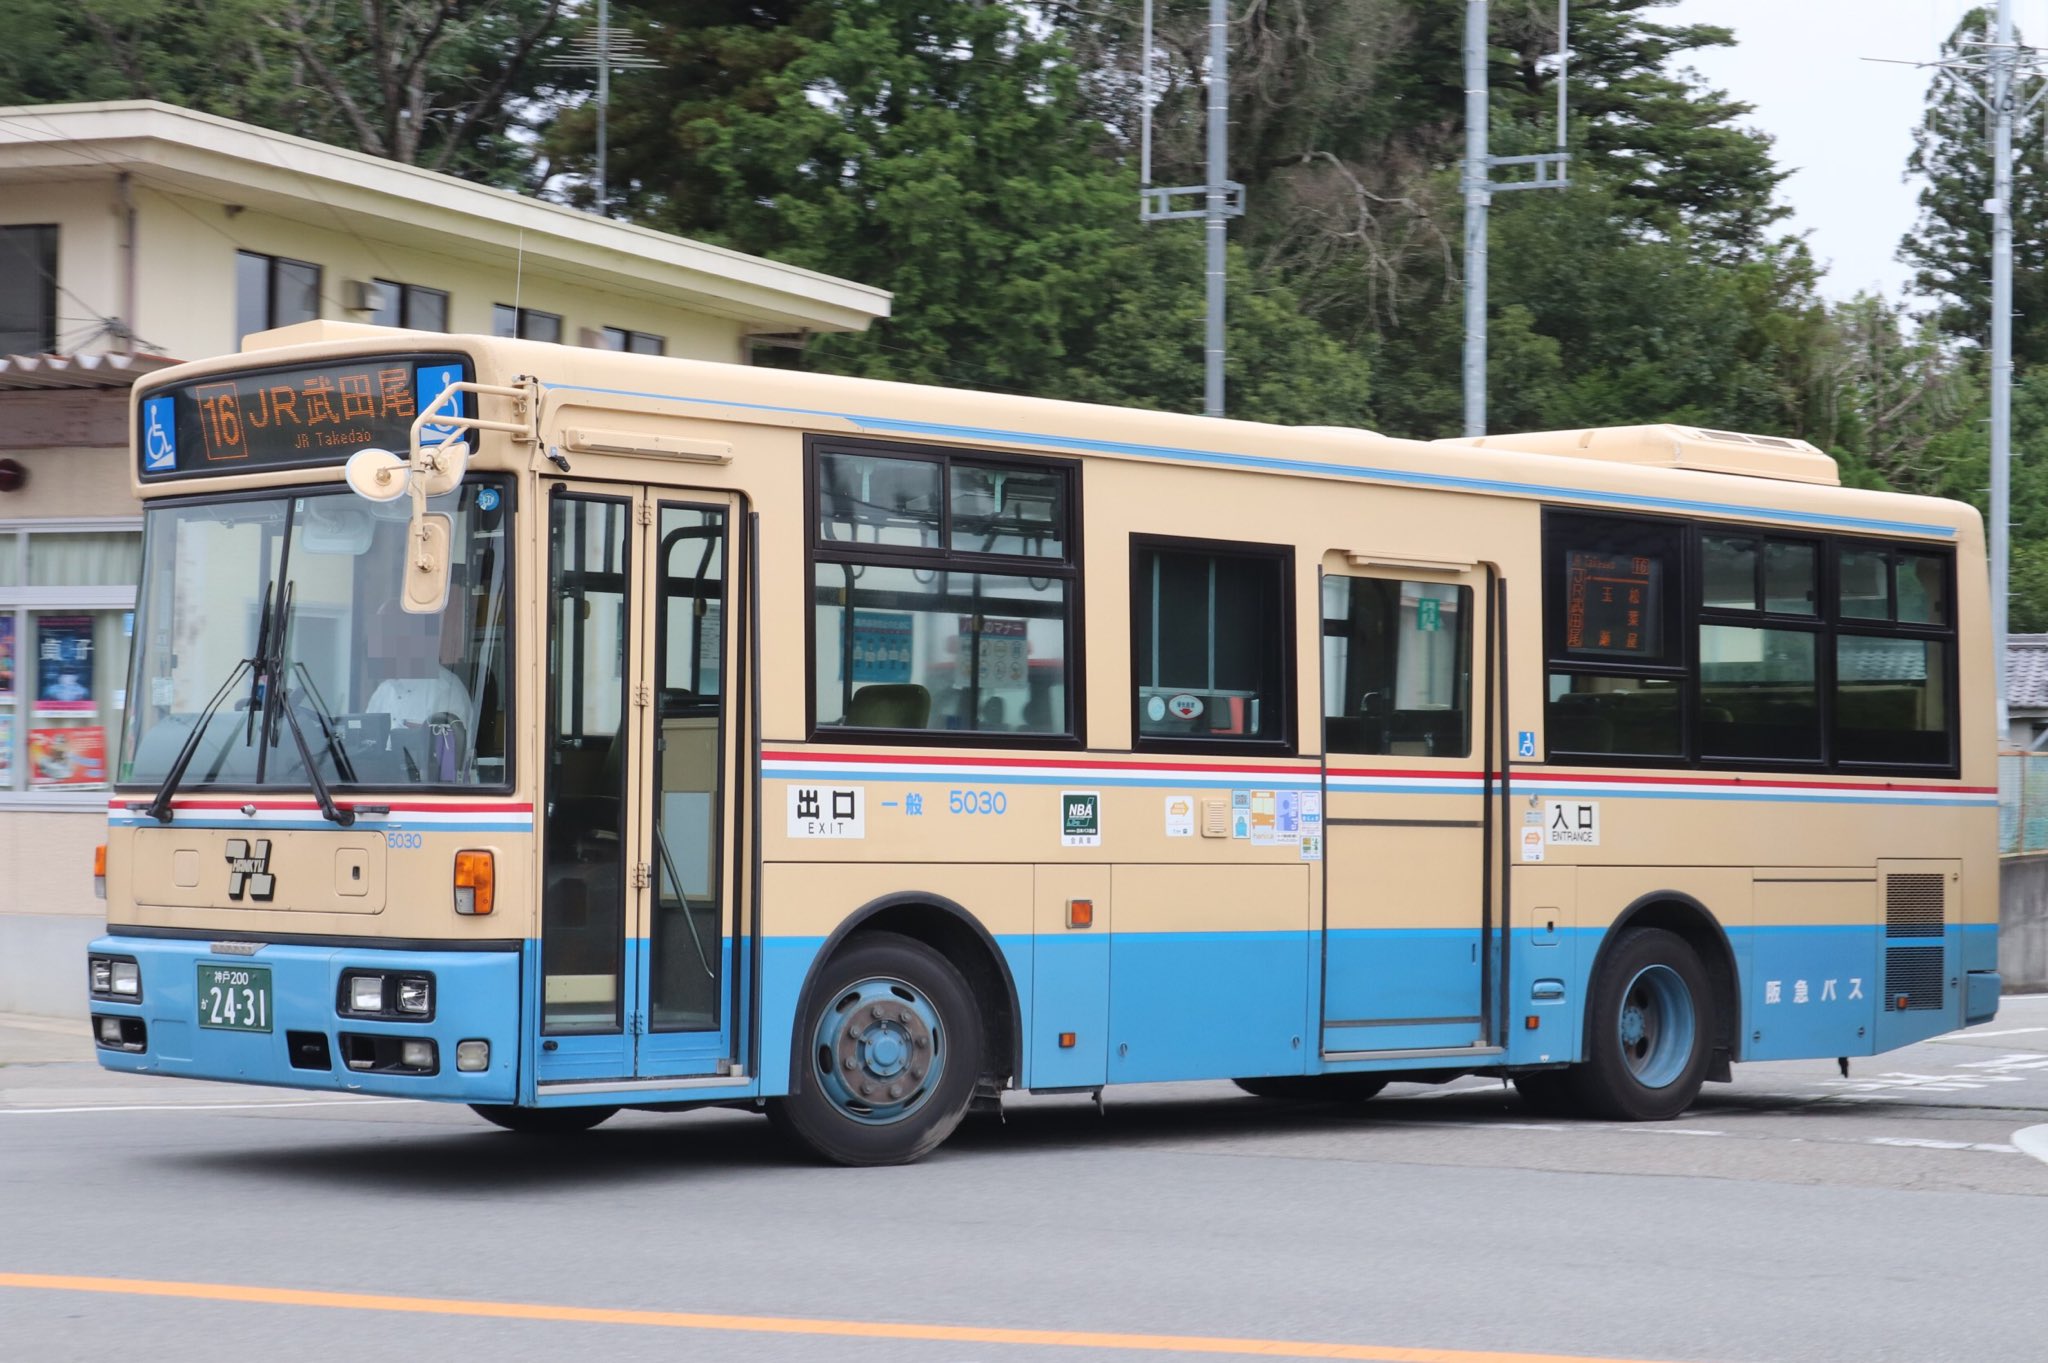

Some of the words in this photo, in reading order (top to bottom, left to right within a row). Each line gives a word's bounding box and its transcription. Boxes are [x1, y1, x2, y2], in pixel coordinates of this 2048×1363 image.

[250, 368, 415, 429] JR武田尾
[203, 393, 239, 448] 16
[797, 789, 855, 820] 出口
[881, 792, 923, 816] 一般
[949, 790, 1007, 815] 5030
[1069, 803, 1093, 816] NBA
[808, 822, 844, 835] EXIT
[1552, 804, 1592, 829] 入口
[387, 832, 422, 849] 5030
[1552, 831, 1592, 842] ENTRANCE
[1765, 978, 1863, 1004] 阪急バス
[210, 986, 265, 1027] 24-31
